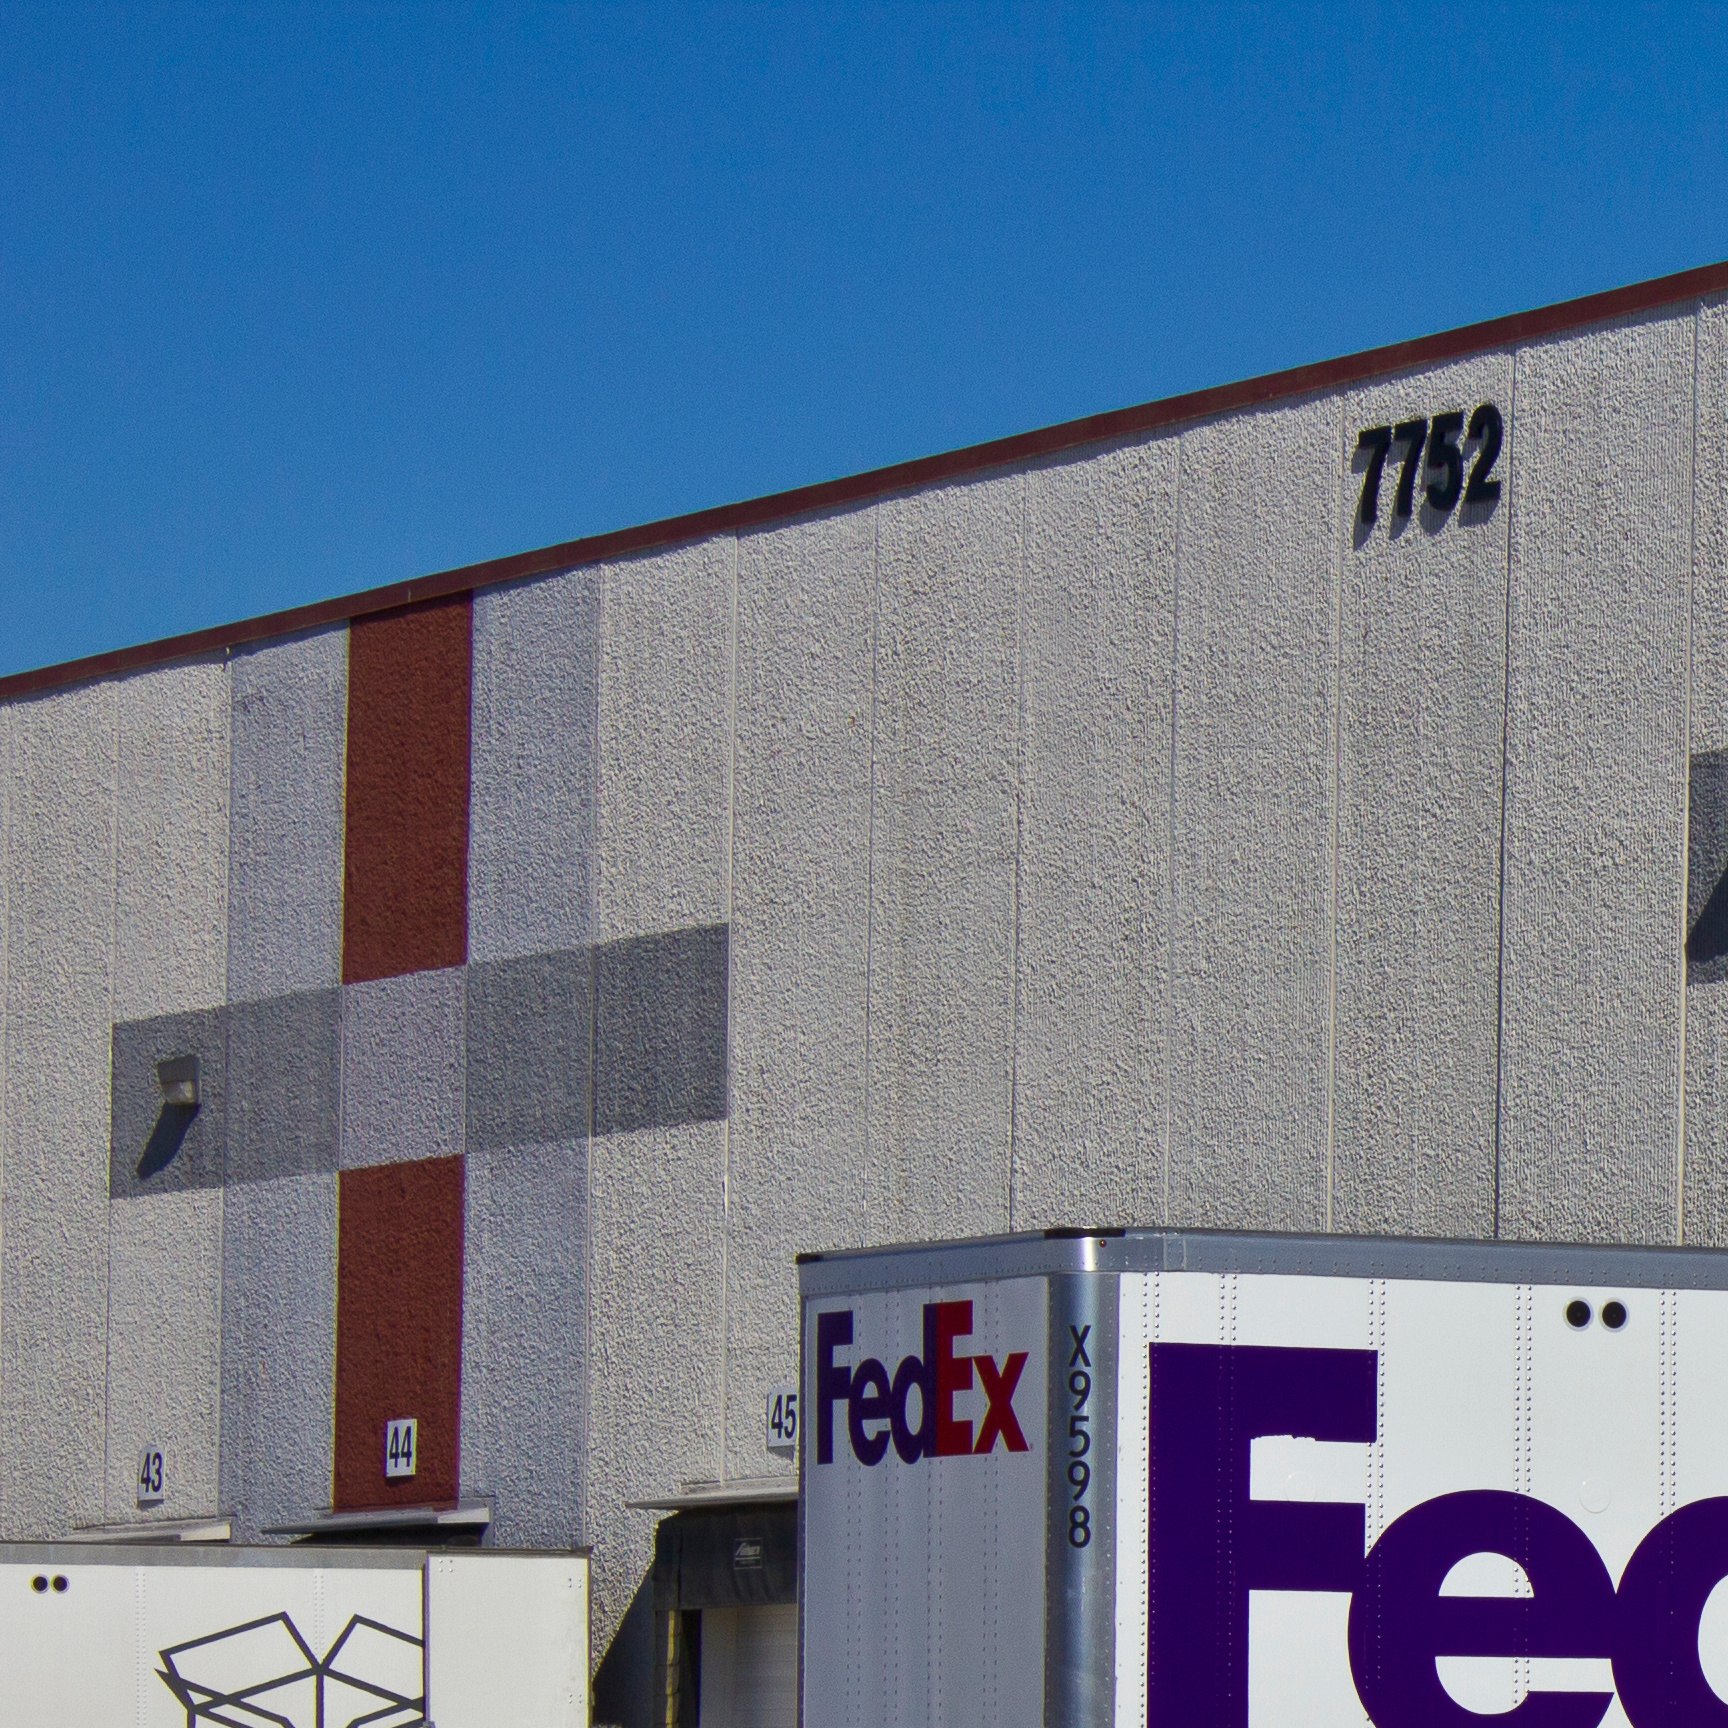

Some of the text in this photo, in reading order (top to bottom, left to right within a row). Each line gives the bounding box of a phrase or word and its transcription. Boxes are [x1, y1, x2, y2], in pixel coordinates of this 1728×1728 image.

[1358, 403, 1503, 525] 7752
[771, 1394, 798, 1439] 45
[816, 1300, 1030, 1467] FedEx
[141, 1452, 163, 1493] 43
[389, 1425, 412, 1469] 44
[1067, 1325, 1092, 1549] X9598
